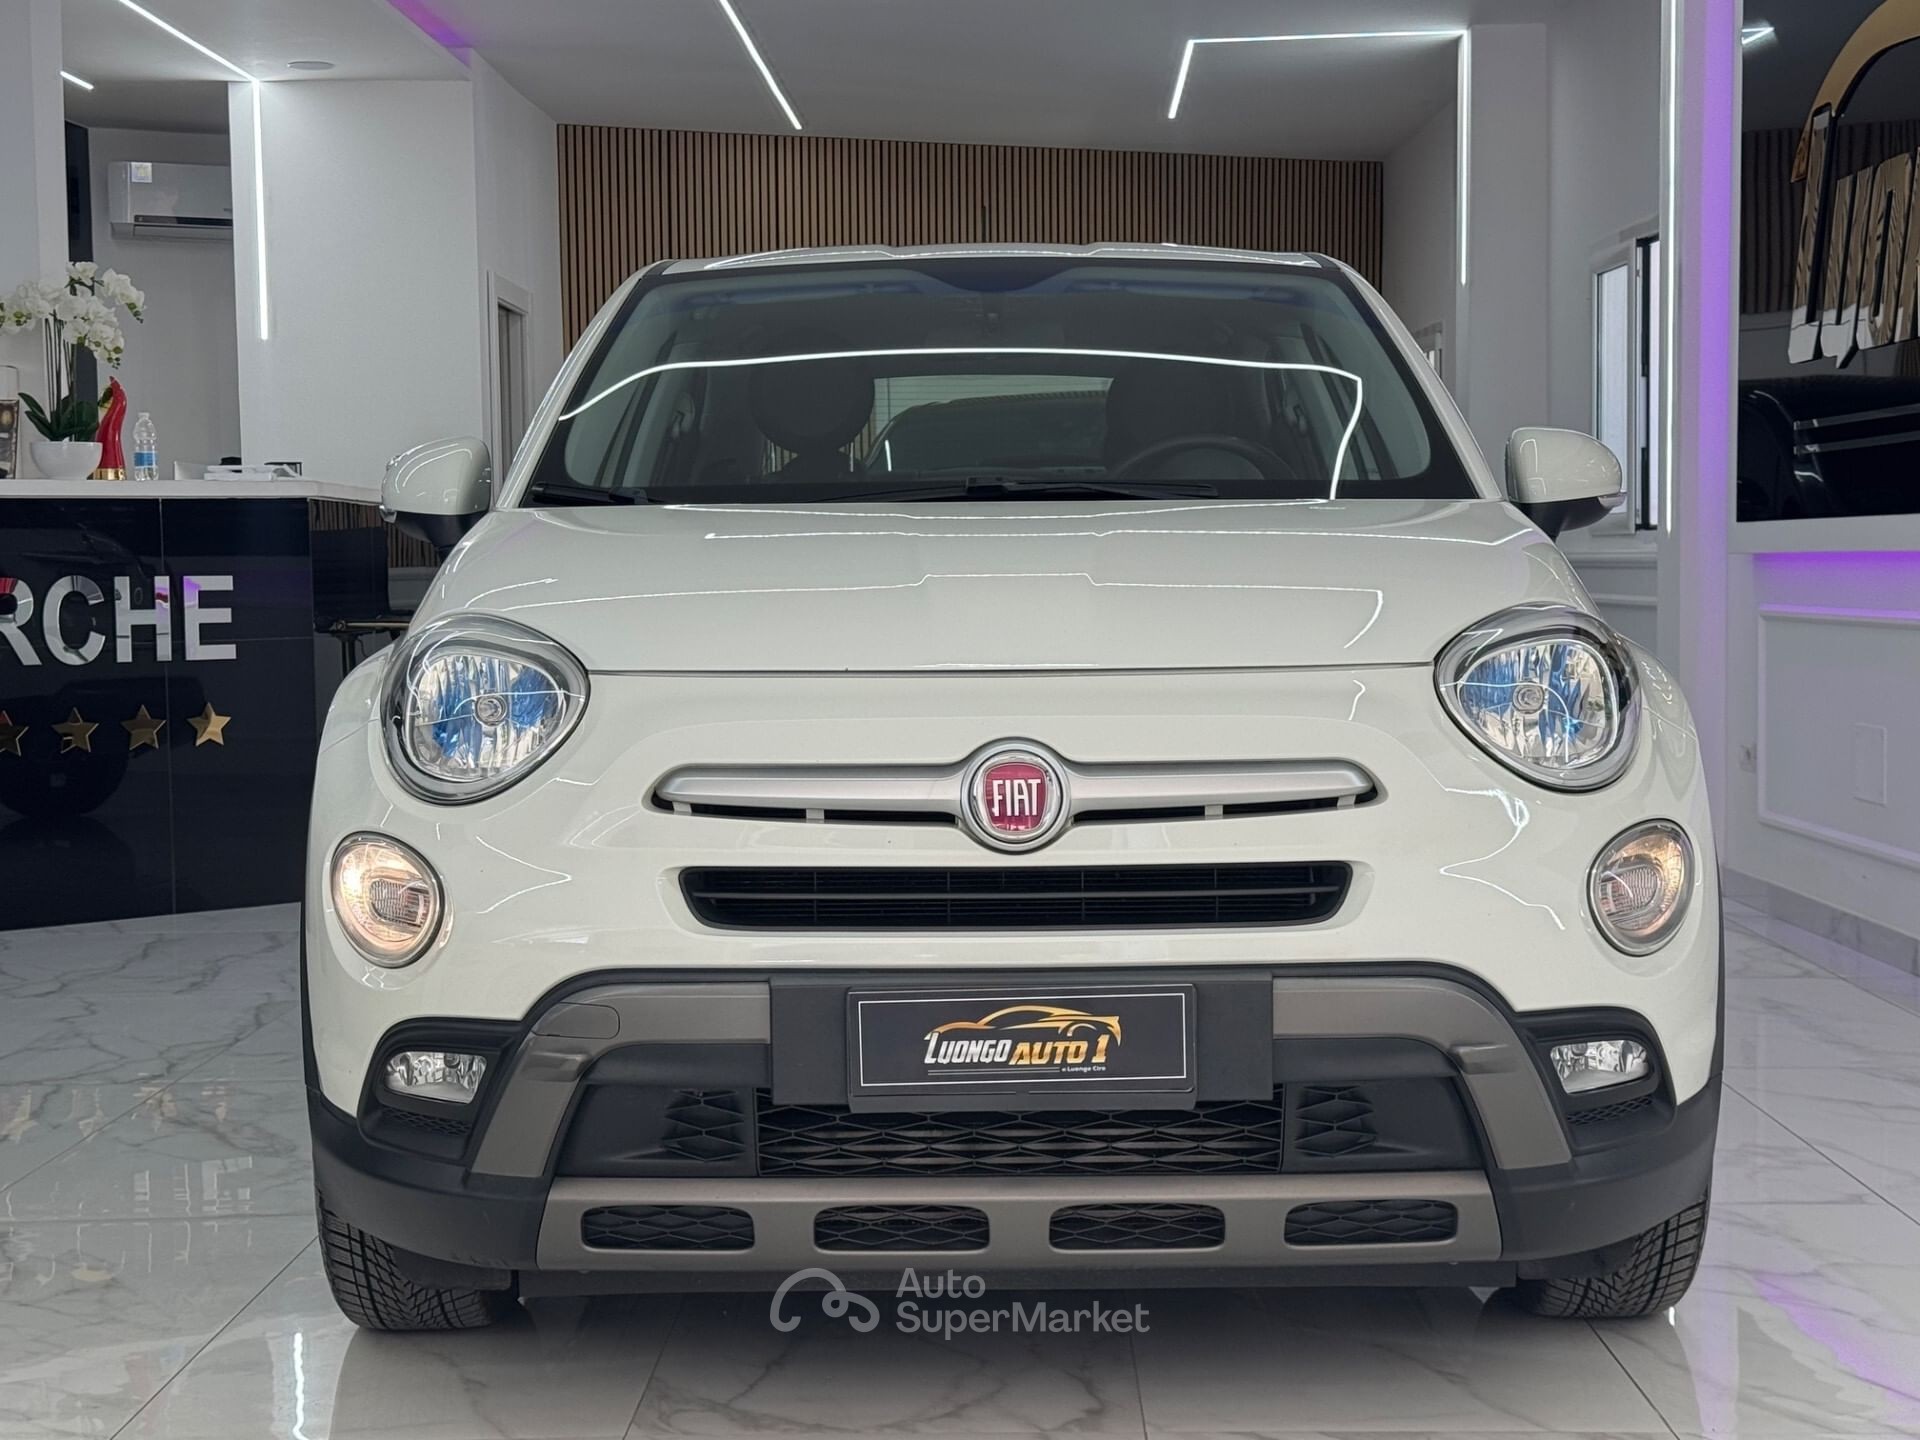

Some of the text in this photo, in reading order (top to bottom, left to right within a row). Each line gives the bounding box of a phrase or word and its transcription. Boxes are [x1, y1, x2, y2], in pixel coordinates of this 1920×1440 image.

[0, 575, 237, 665] RCHE
[992, 778, 1041, 817] FIAT
[924, 1032, 1110, 1065] LUONGO AUTO 1
